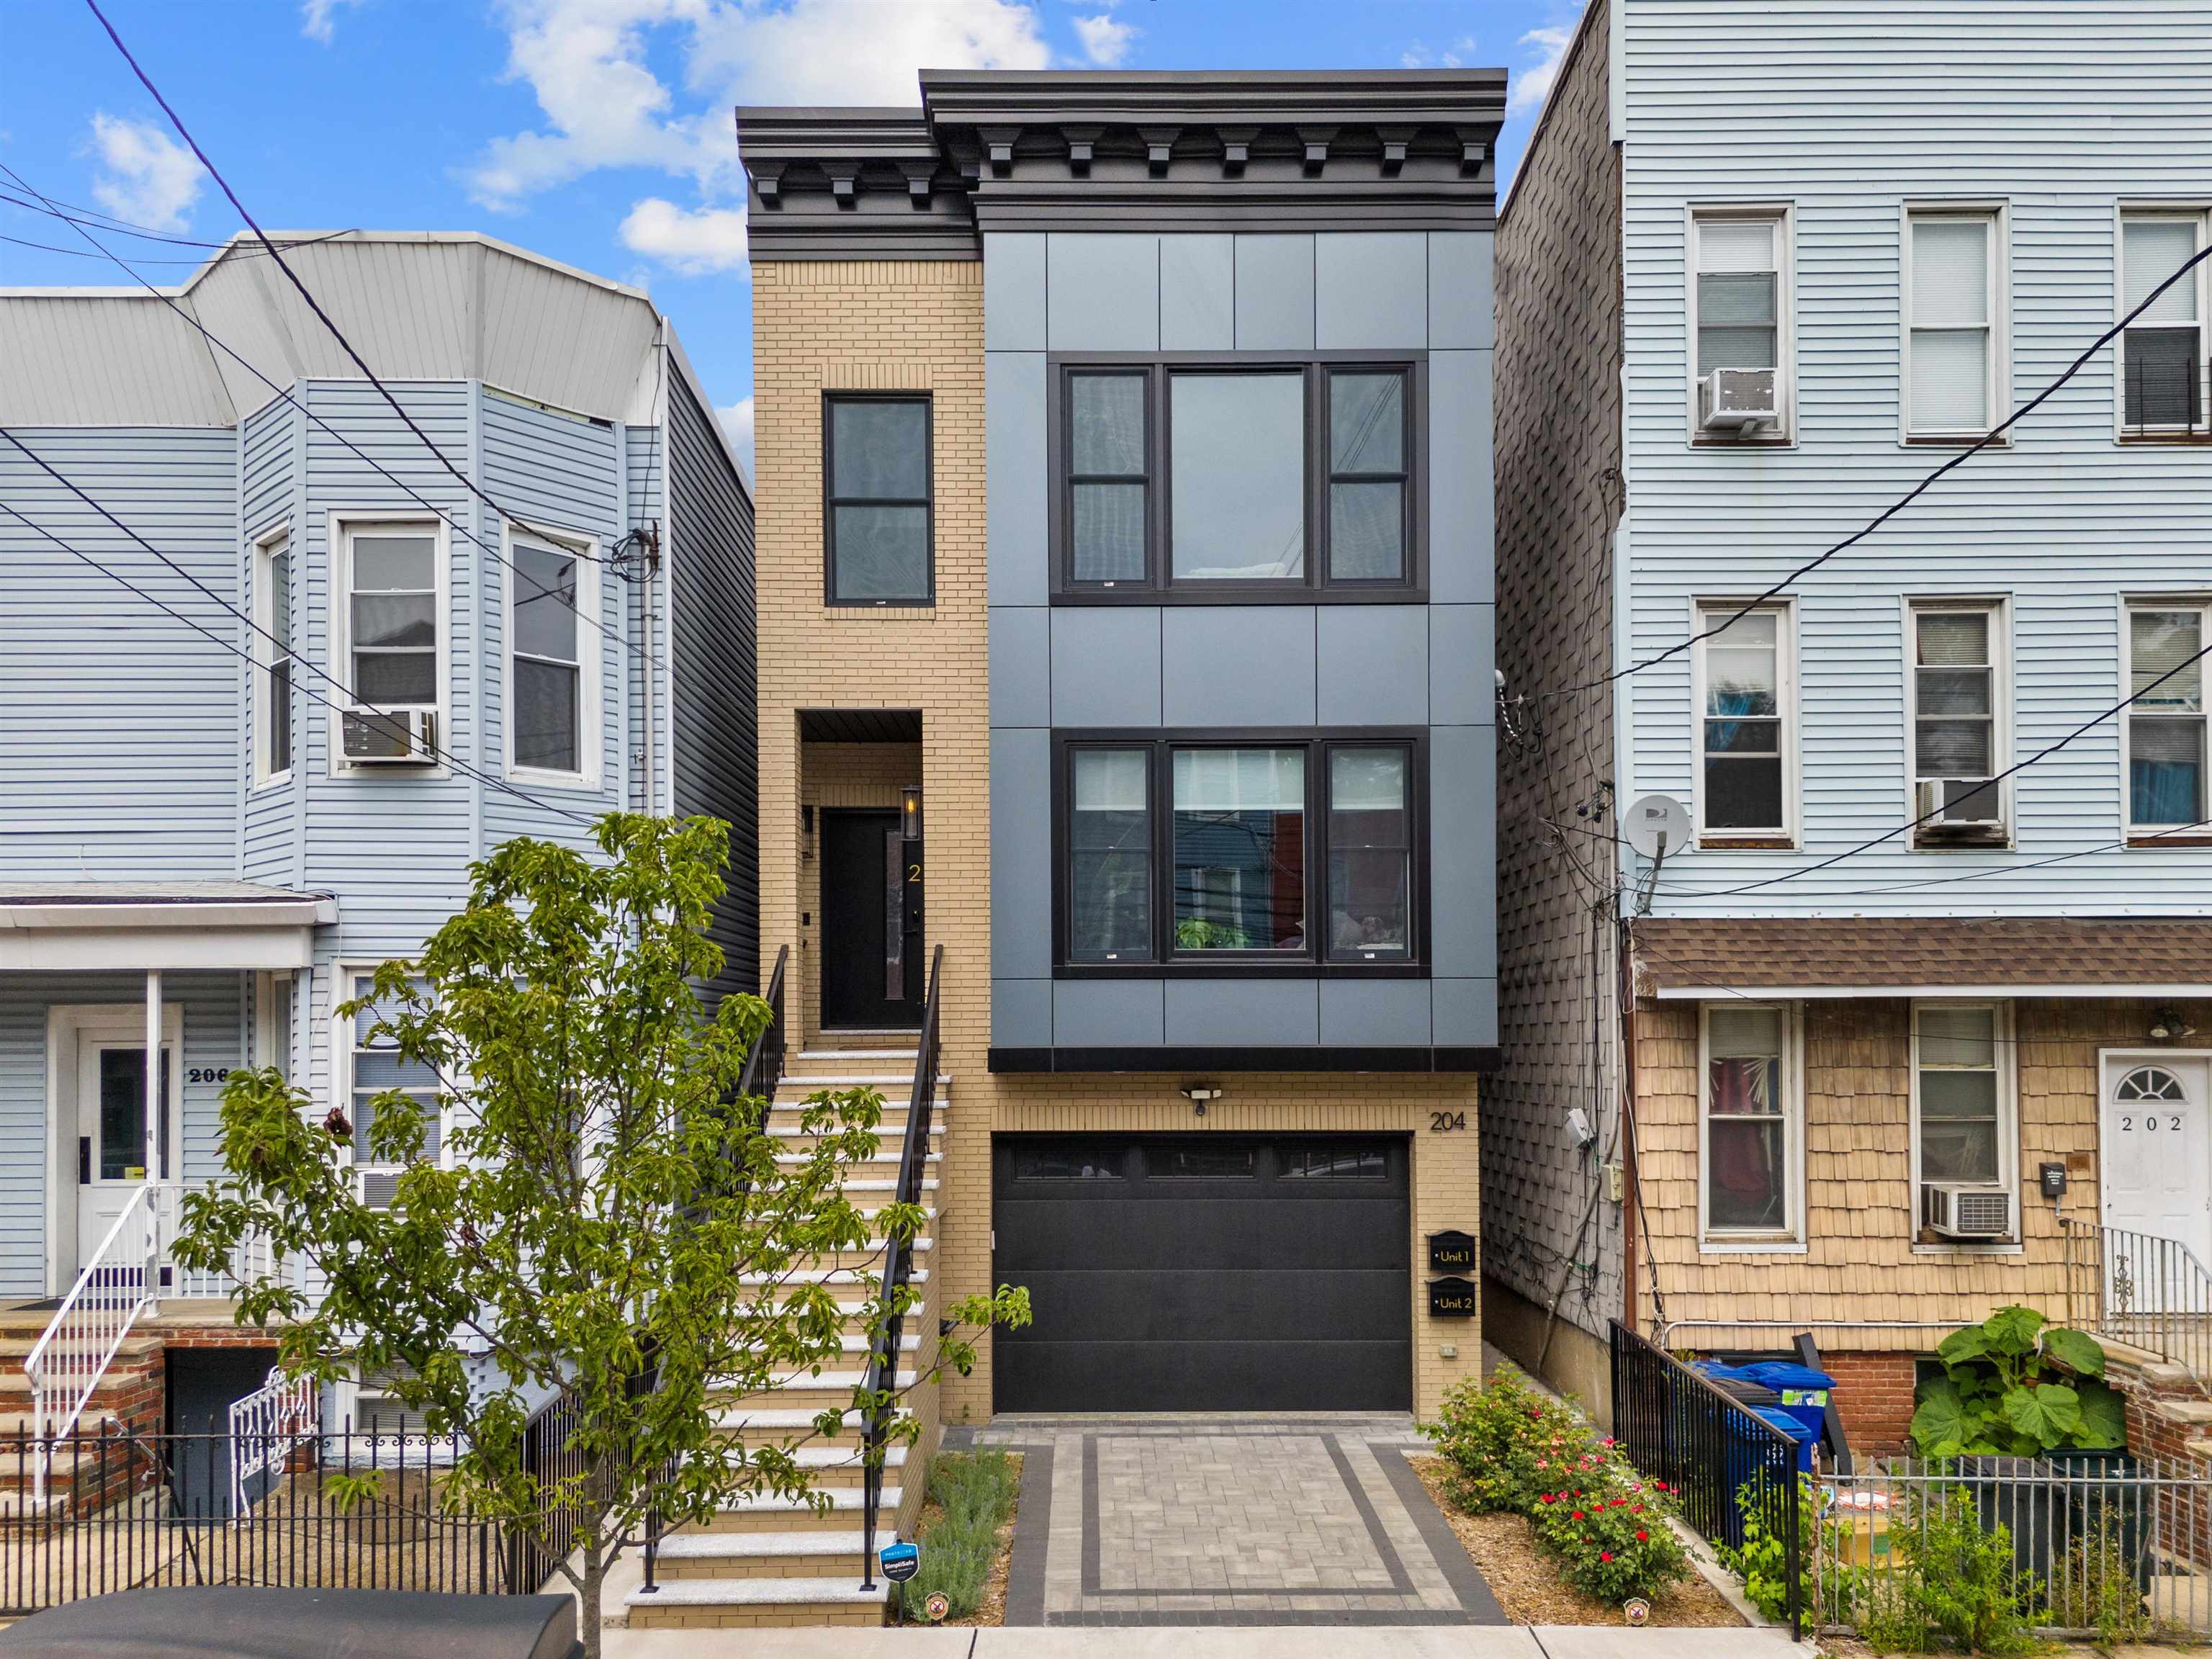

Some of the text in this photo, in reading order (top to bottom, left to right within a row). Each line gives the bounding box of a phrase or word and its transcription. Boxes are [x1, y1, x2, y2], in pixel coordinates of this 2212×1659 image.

[909, 864, 921, 881] 2
[189, 1069, 229, 1082] 206
[1430, 1111, 1466, 1130] 204
[1440, 1251, 1469, 1262] Unit 1
[1440, 1298, 1472, 1308] Unit 2
[884, 1560, 914, 1569] SimpliSafe
